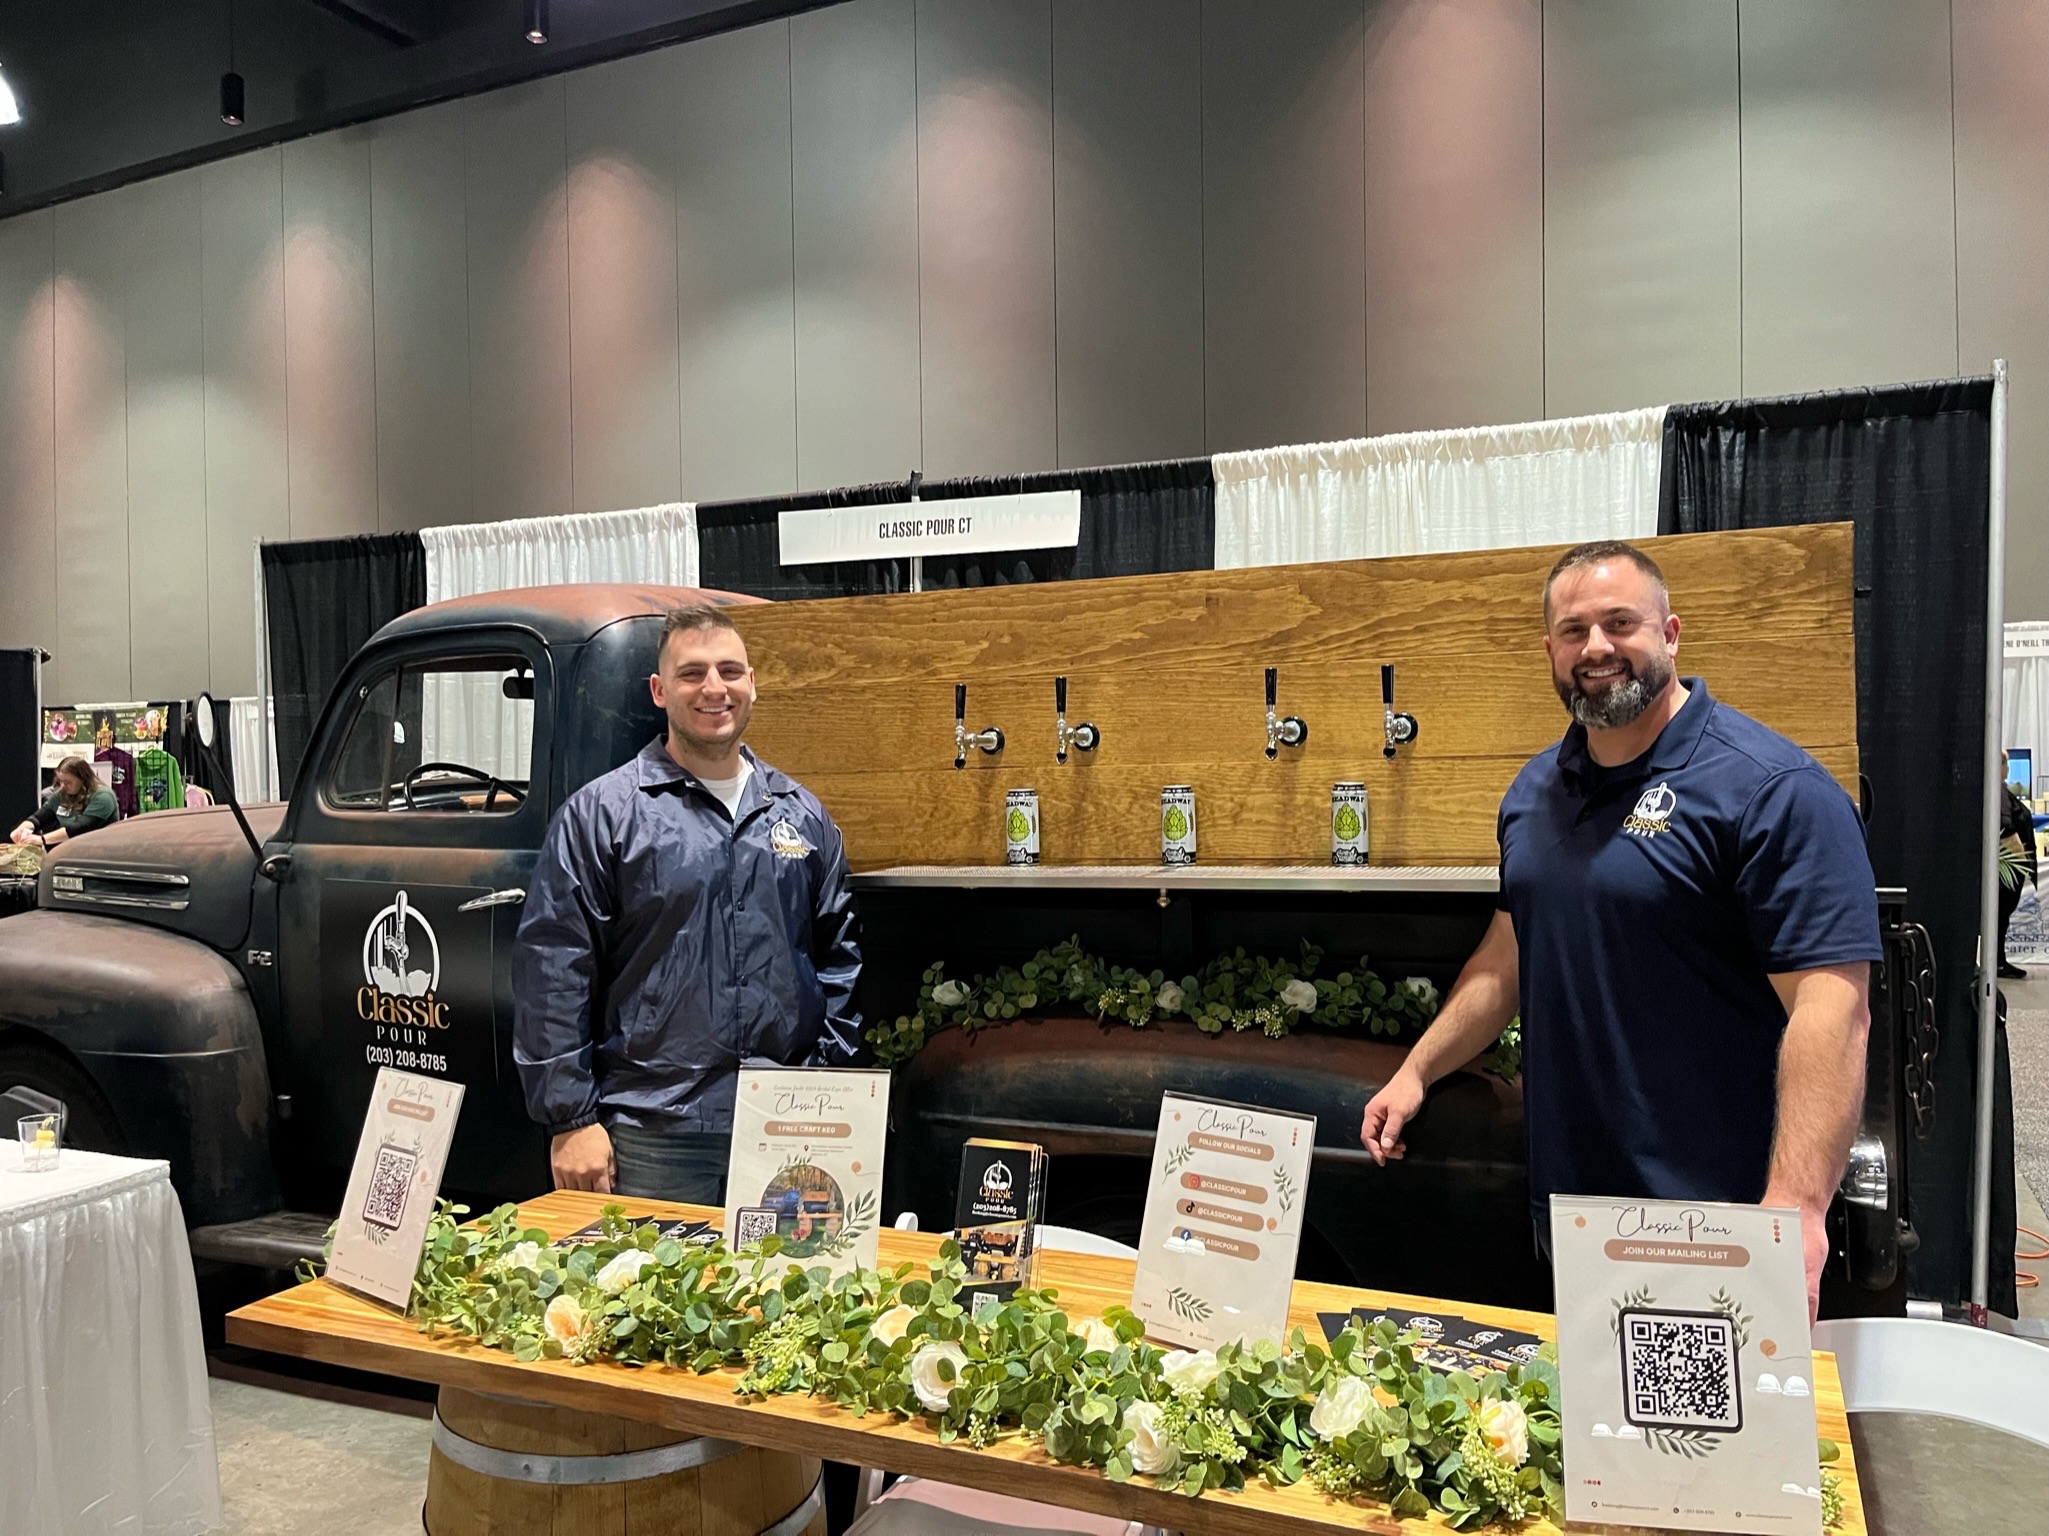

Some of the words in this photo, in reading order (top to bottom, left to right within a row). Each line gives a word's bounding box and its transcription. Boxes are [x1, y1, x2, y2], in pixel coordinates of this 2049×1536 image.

[879, 520, 923, 539] CLASSIC
[926, 518, 955, 536] POUR
[958, 517, 973, 534] CT
[1623, 815, 1671, 833] Classic
[1626, 827, 1656, 838] POUR
[357, 986, 451, 1030] Classic
[376, 1025, 427, 1046] POUR
[366, 1044, 394, 1067] (203)
[395, 1049, 447, 1072] 208-8785
[774, 1093, 816, 1115] Classic
[815, 1093, 845, 1116] Pour
[1198, 1107, 1238, 1131] Classic
[1237, 1114, 1267, 1139] Pour
[1198, 1137, 1223, 1148] FOLLOW
[1222, 1142, 1236, 1150] OUR
[1236, 1145, 1261, 1155] SOCIALS
[980, 1186, 1014, 1200] Classic
[1200, 1180, 1247, 1195] @CLASSICPOUR
[1197, 1207, 1243, 1223] @CLASSICPOUR
[1612, 1206, 1683, 1237] Classic
[1680, 1209, 1732, 1242] Pour
[1622, 1246, 1645, 1255] JOIN
[1646, 1247, 1666, 1256] OUR
[1667, 1248, 1707, 1258] MAILING
[1708, 1251, 1729, 1260] LIST
